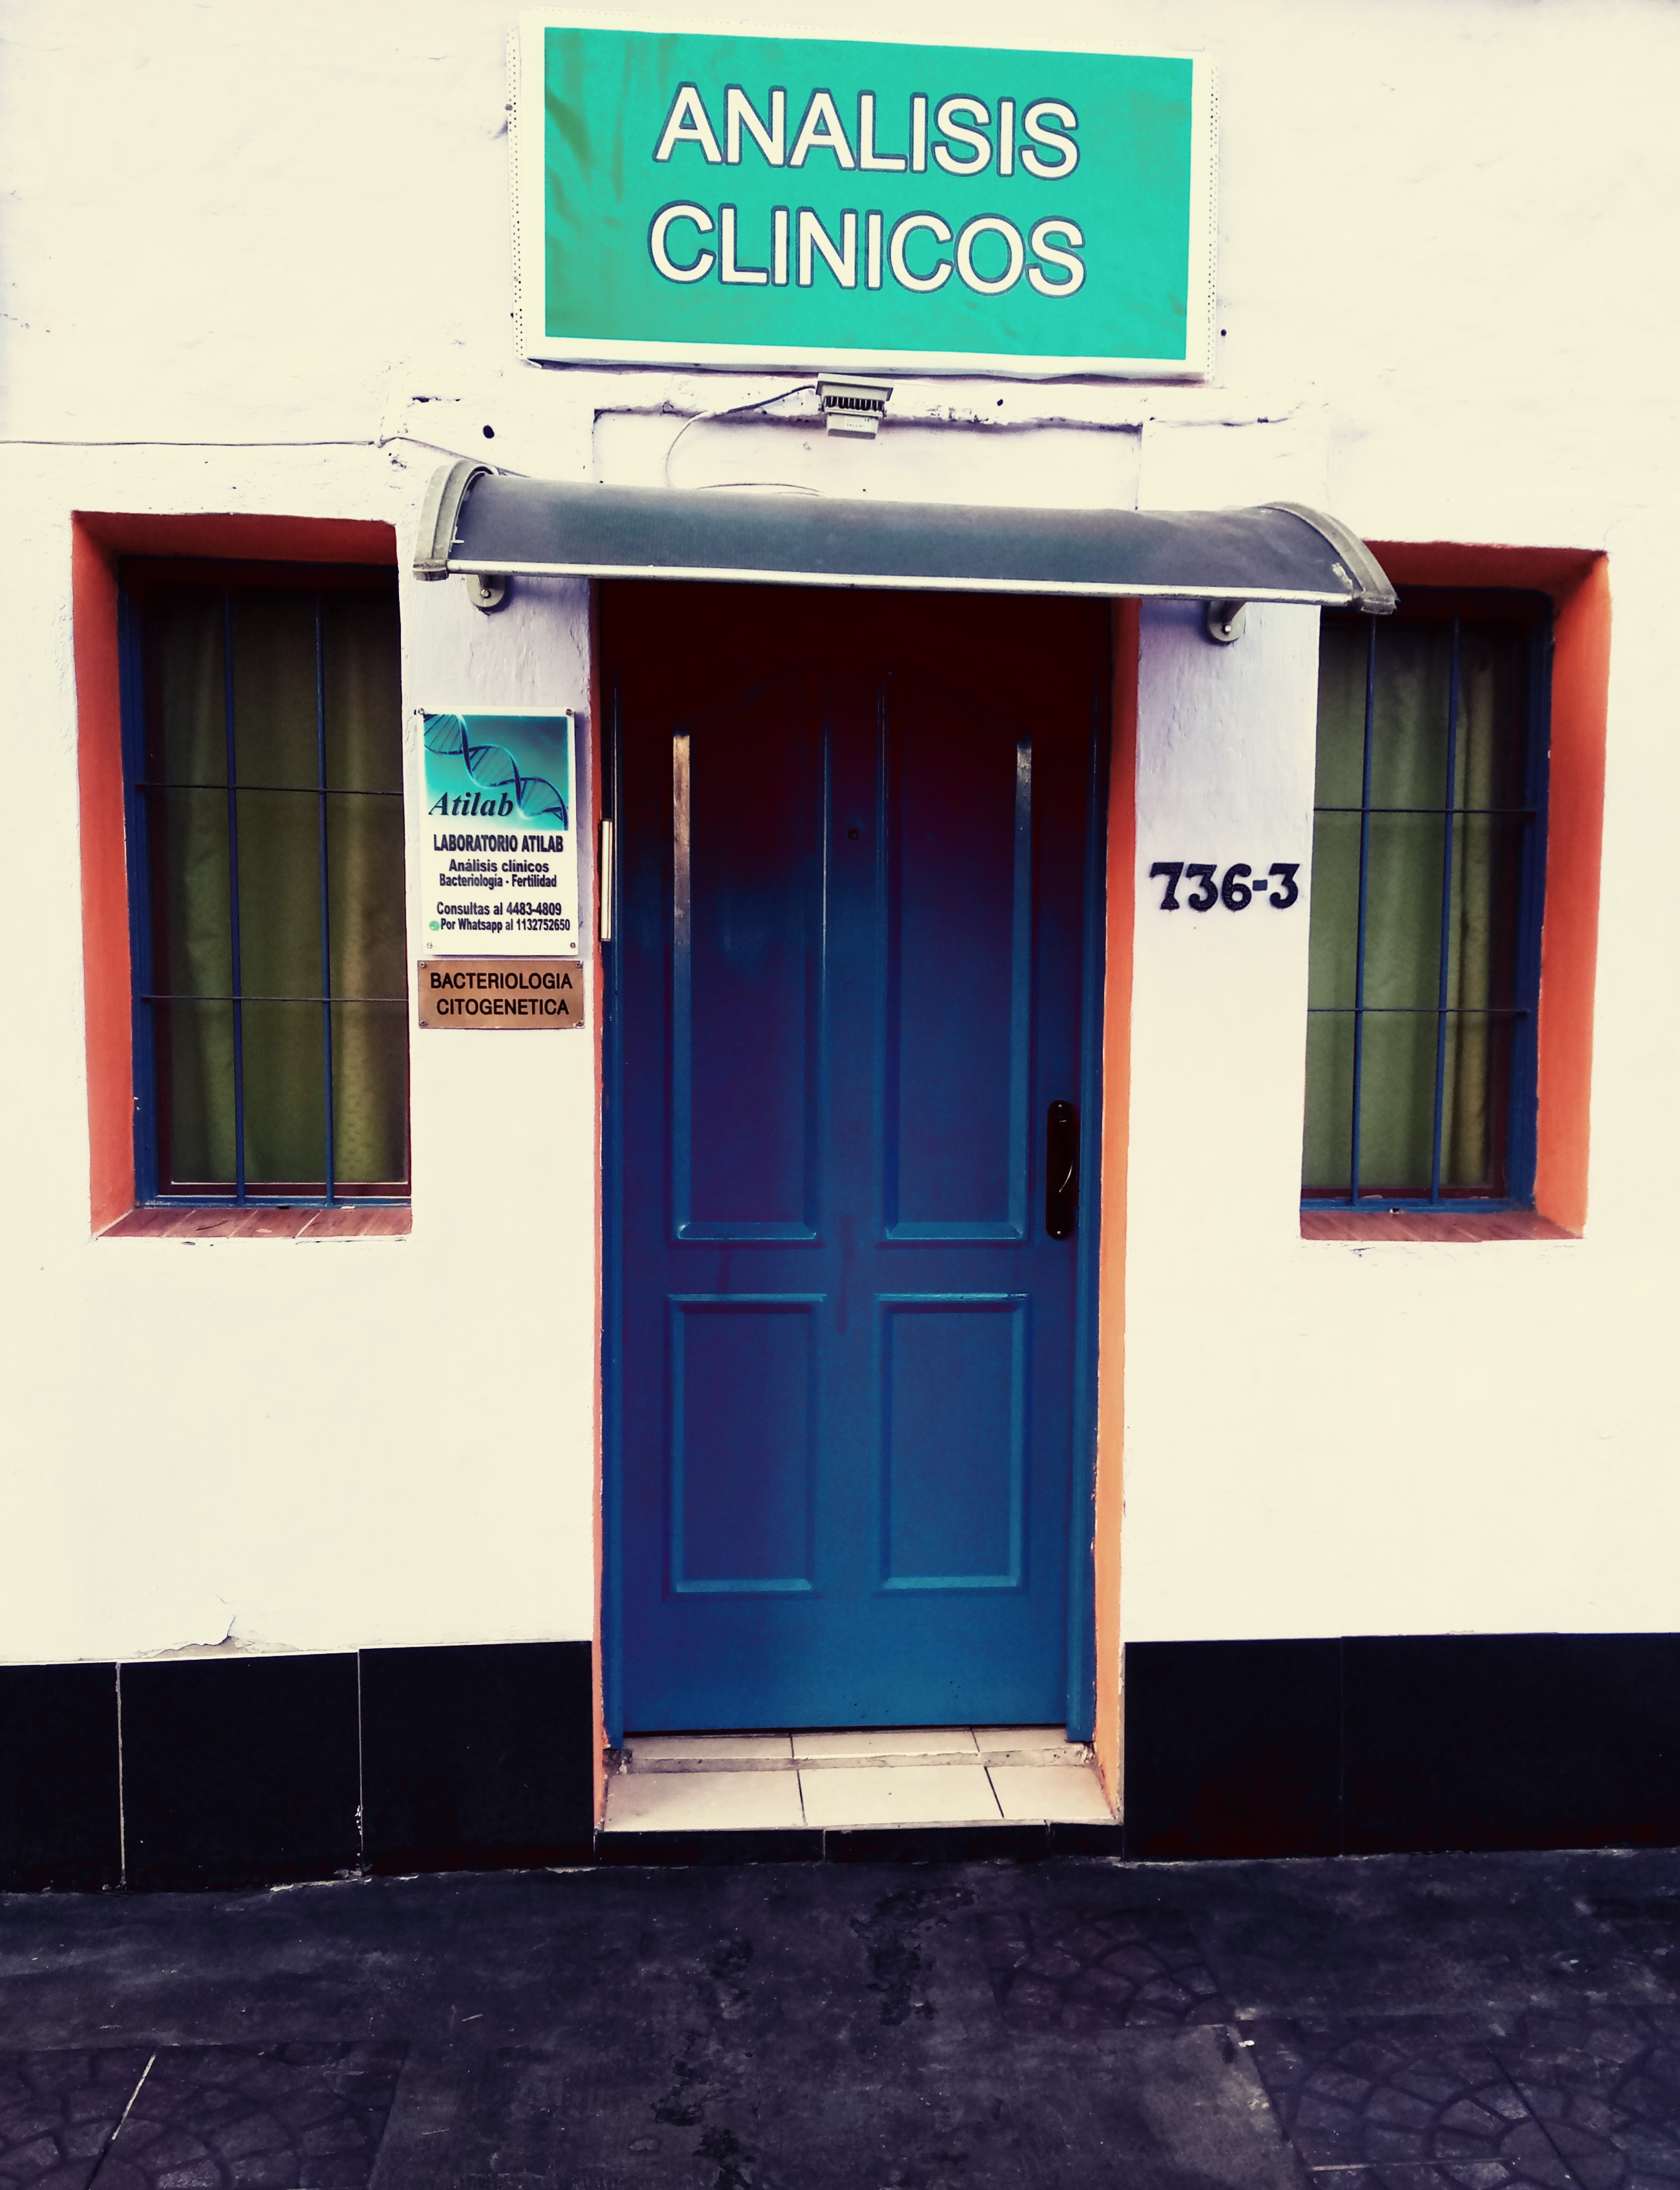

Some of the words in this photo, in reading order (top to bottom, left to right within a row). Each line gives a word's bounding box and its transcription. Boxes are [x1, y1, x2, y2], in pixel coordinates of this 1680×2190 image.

[652, 81, 1080, 180] ANALISIS
[648, 200, 1087, 298] CLINICOS
[428, 792, 513, 816] Atilab
[433, 834, 518, 852] LABORATORIO
[522, 835, 563, 852] ATILAB
[449, 859, 497, 872] Análisis
[502, 860, 549, 873] clínicos
[511, 874, 557, 887] Fertilidad
[1149, 862, 1300, 911] 736-3
[436, 902, 490, 915] Consultas
[493, 902, 503, 915] al
[506, 902, 561, 915] 4483-4809
[441, 918, 455, 930] Por
[458, 918, 502, 933] Whatsapp
[506, 918, 513, 930] al
[517, 918, 570, 931] 1132752650
[431, 973, 572, 989] BACTERIOLOGIA
[436, 999, 569, 1015] CITOGENETICA
